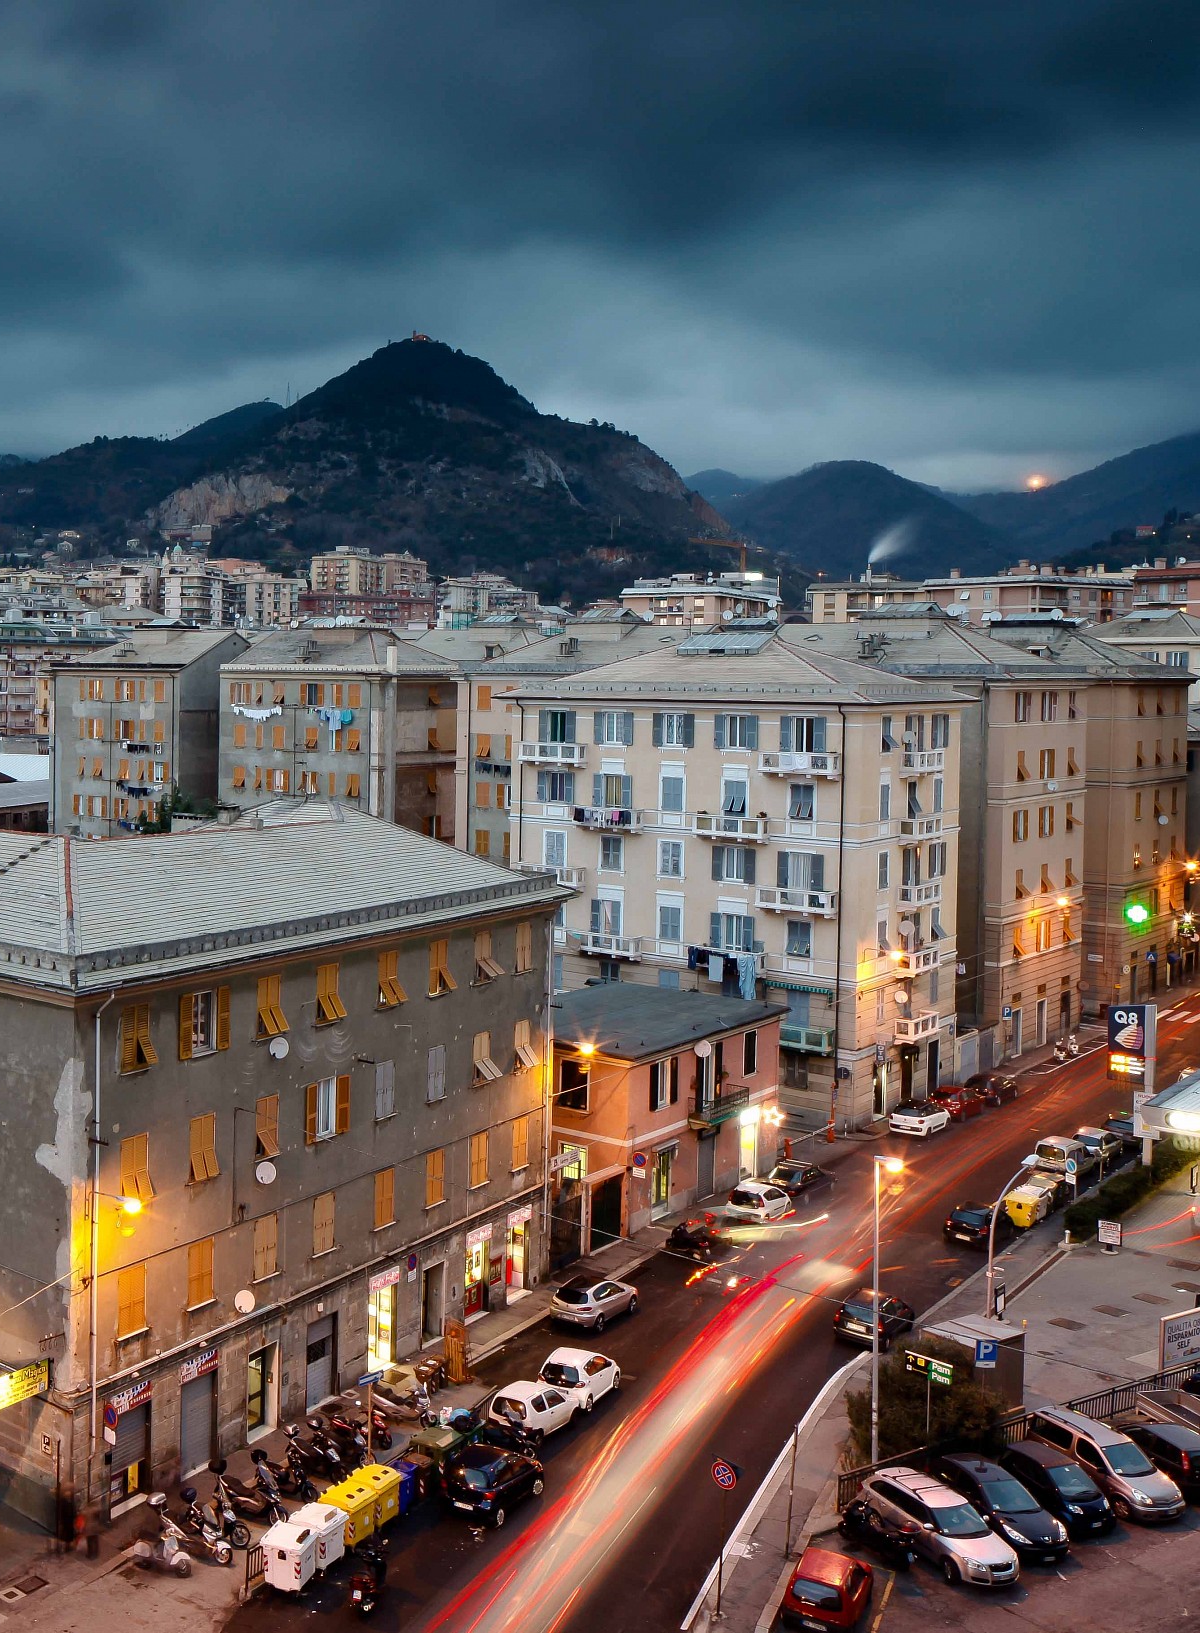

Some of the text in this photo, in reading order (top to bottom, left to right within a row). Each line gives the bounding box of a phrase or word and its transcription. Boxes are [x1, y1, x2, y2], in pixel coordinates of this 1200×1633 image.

[1114, 1010, 1139, 1025] Q8
[980, 1341, 993, 1359] P
[1177, 1339, 1191, 1350] SELF
[931, 1362, 950, 1375] Pam
[931, 1371, 950, 1385] Pam
